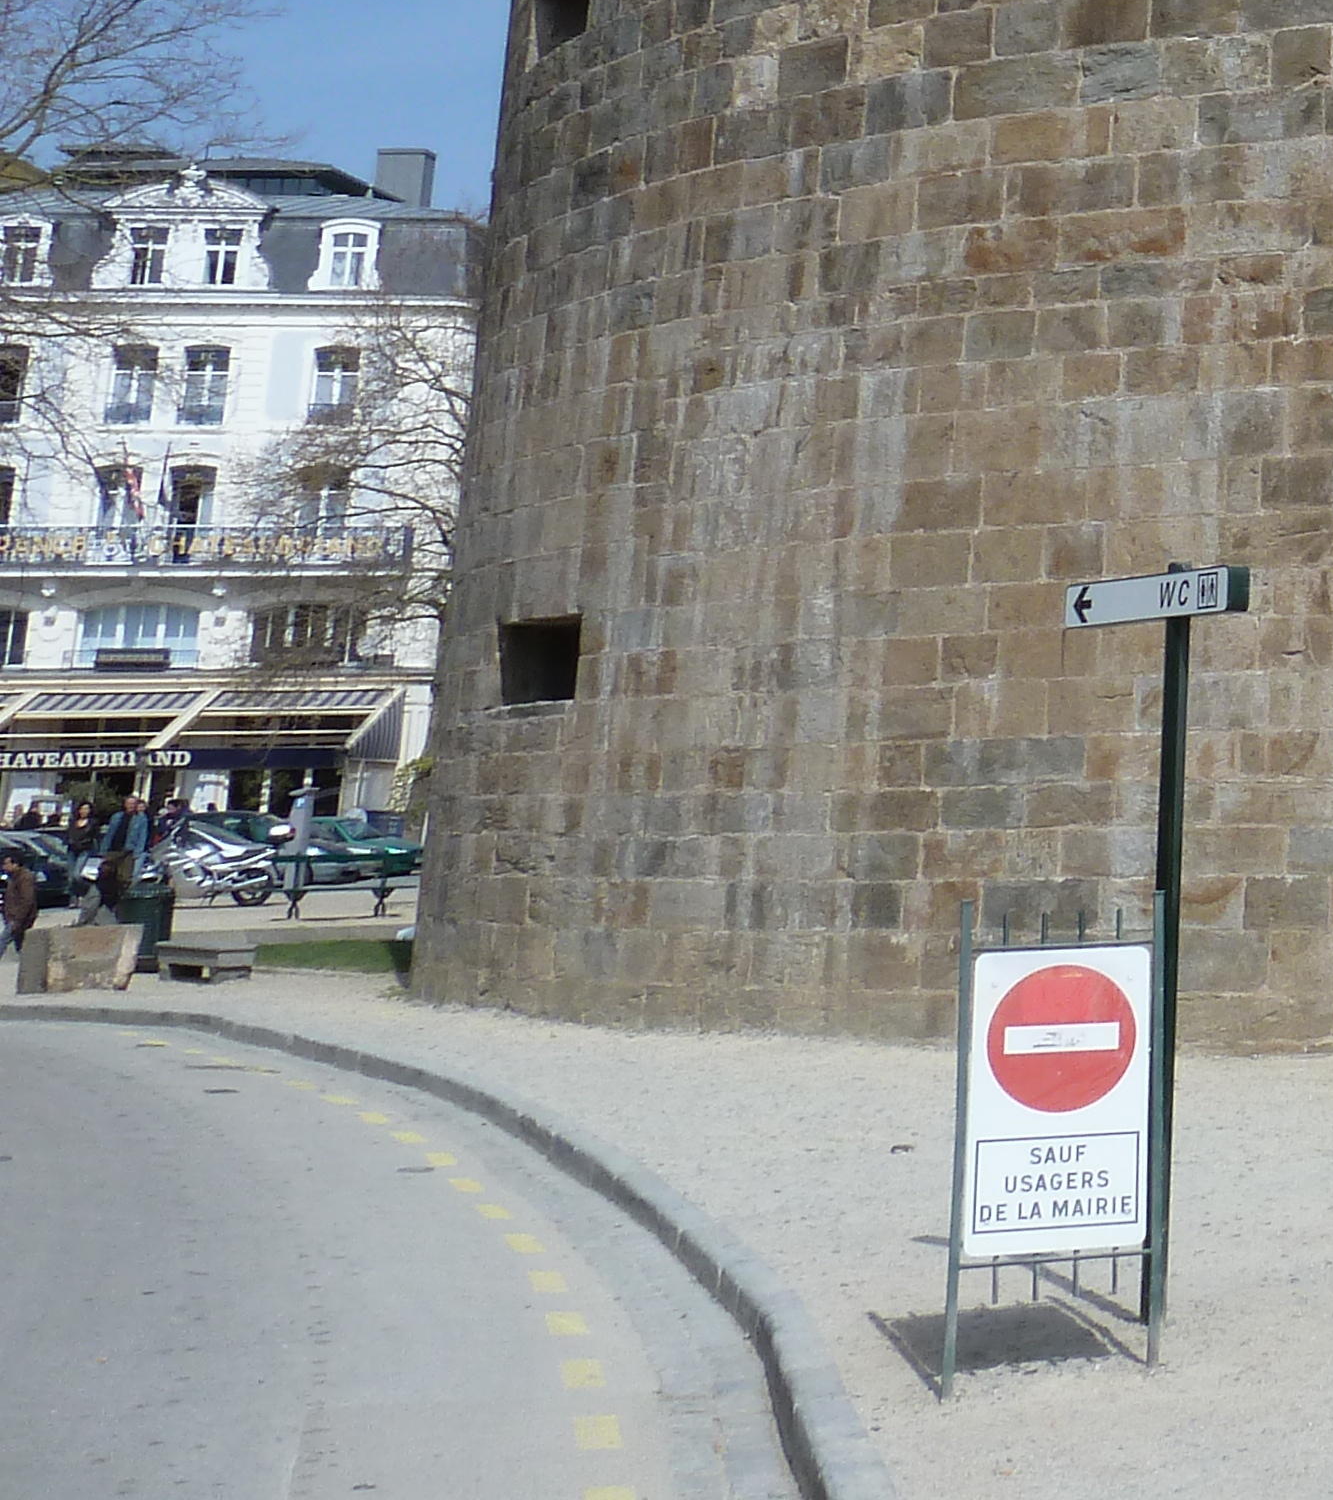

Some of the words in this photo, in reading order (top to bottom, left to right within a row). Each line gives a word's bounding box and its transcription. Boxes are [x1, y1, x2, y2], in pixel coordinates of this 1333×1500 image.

[1160, 580, 1190, 609] WC
[1030, 1144, 1087, 1165] SAUF
[1005, 1170, 1109, 1193] USAGERS
[979, 1203, 1007, 1223] DE
[1018, 1201, 1042, 1220] LA
[1051, 1195, 1132, 1218] MAIRIE
